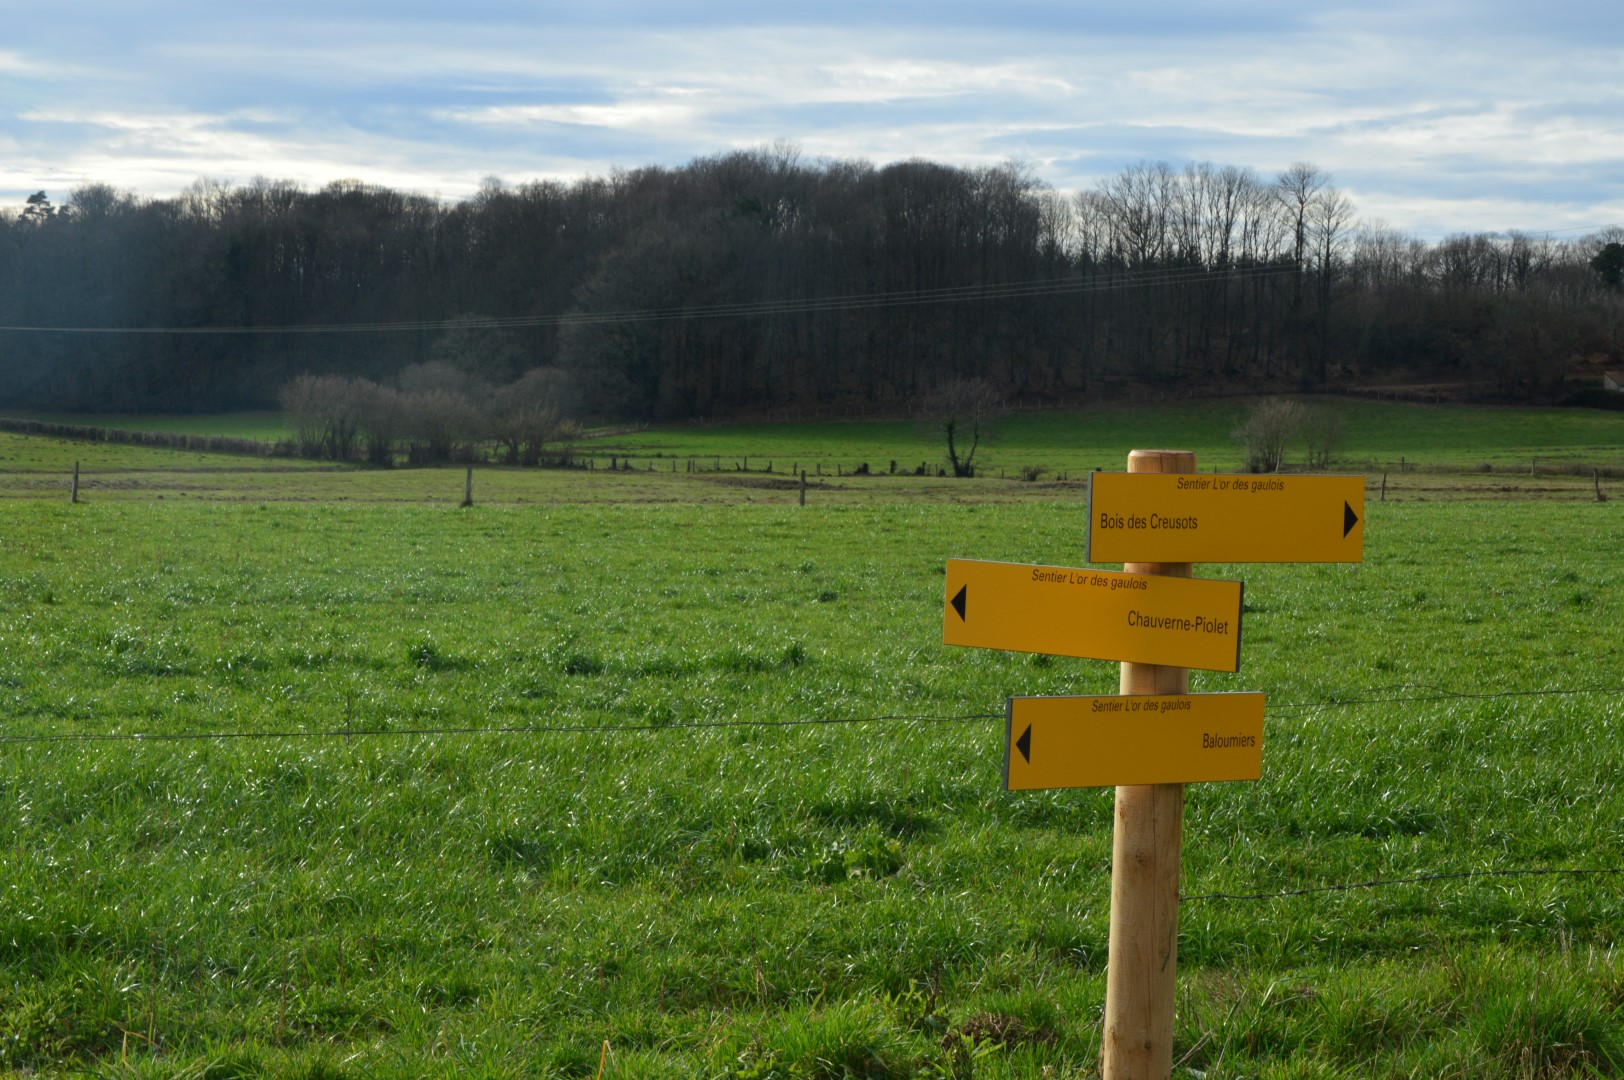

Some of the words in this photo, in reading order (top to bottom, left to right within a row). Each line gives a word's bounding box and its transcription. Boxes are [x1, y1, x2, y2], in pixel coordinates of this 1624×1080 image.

[1176, 477, 1210, 490] Sentier
[1212, 477, 1230, 490] L'or
[1232, 478, 1249, 491] des
[1251, 478, 1285, 493] gaulois
[1100, 513, 1124, 529] Bois
[1127, 513, 1147, 529] des
[1150, 513, 1198, 530] Creusots
[1031, 568, 1067, 584] Sentier
[1069, 572, 1087, 586] L'or
[1090, 573, 1108, 588] des
[1110, 576, 1148, 591] gaulois
[1127, 610, 1229, 635] Chauverne-Piolet
[1091, 699, 1123, 713] Sentier
[1125, 699, 1141, 712] L'or
[1143, 699, 1158, 711] des
[1160, 698, 1192, 714] gaulois
[1202, 732, 1256, 749] Baloumiers
